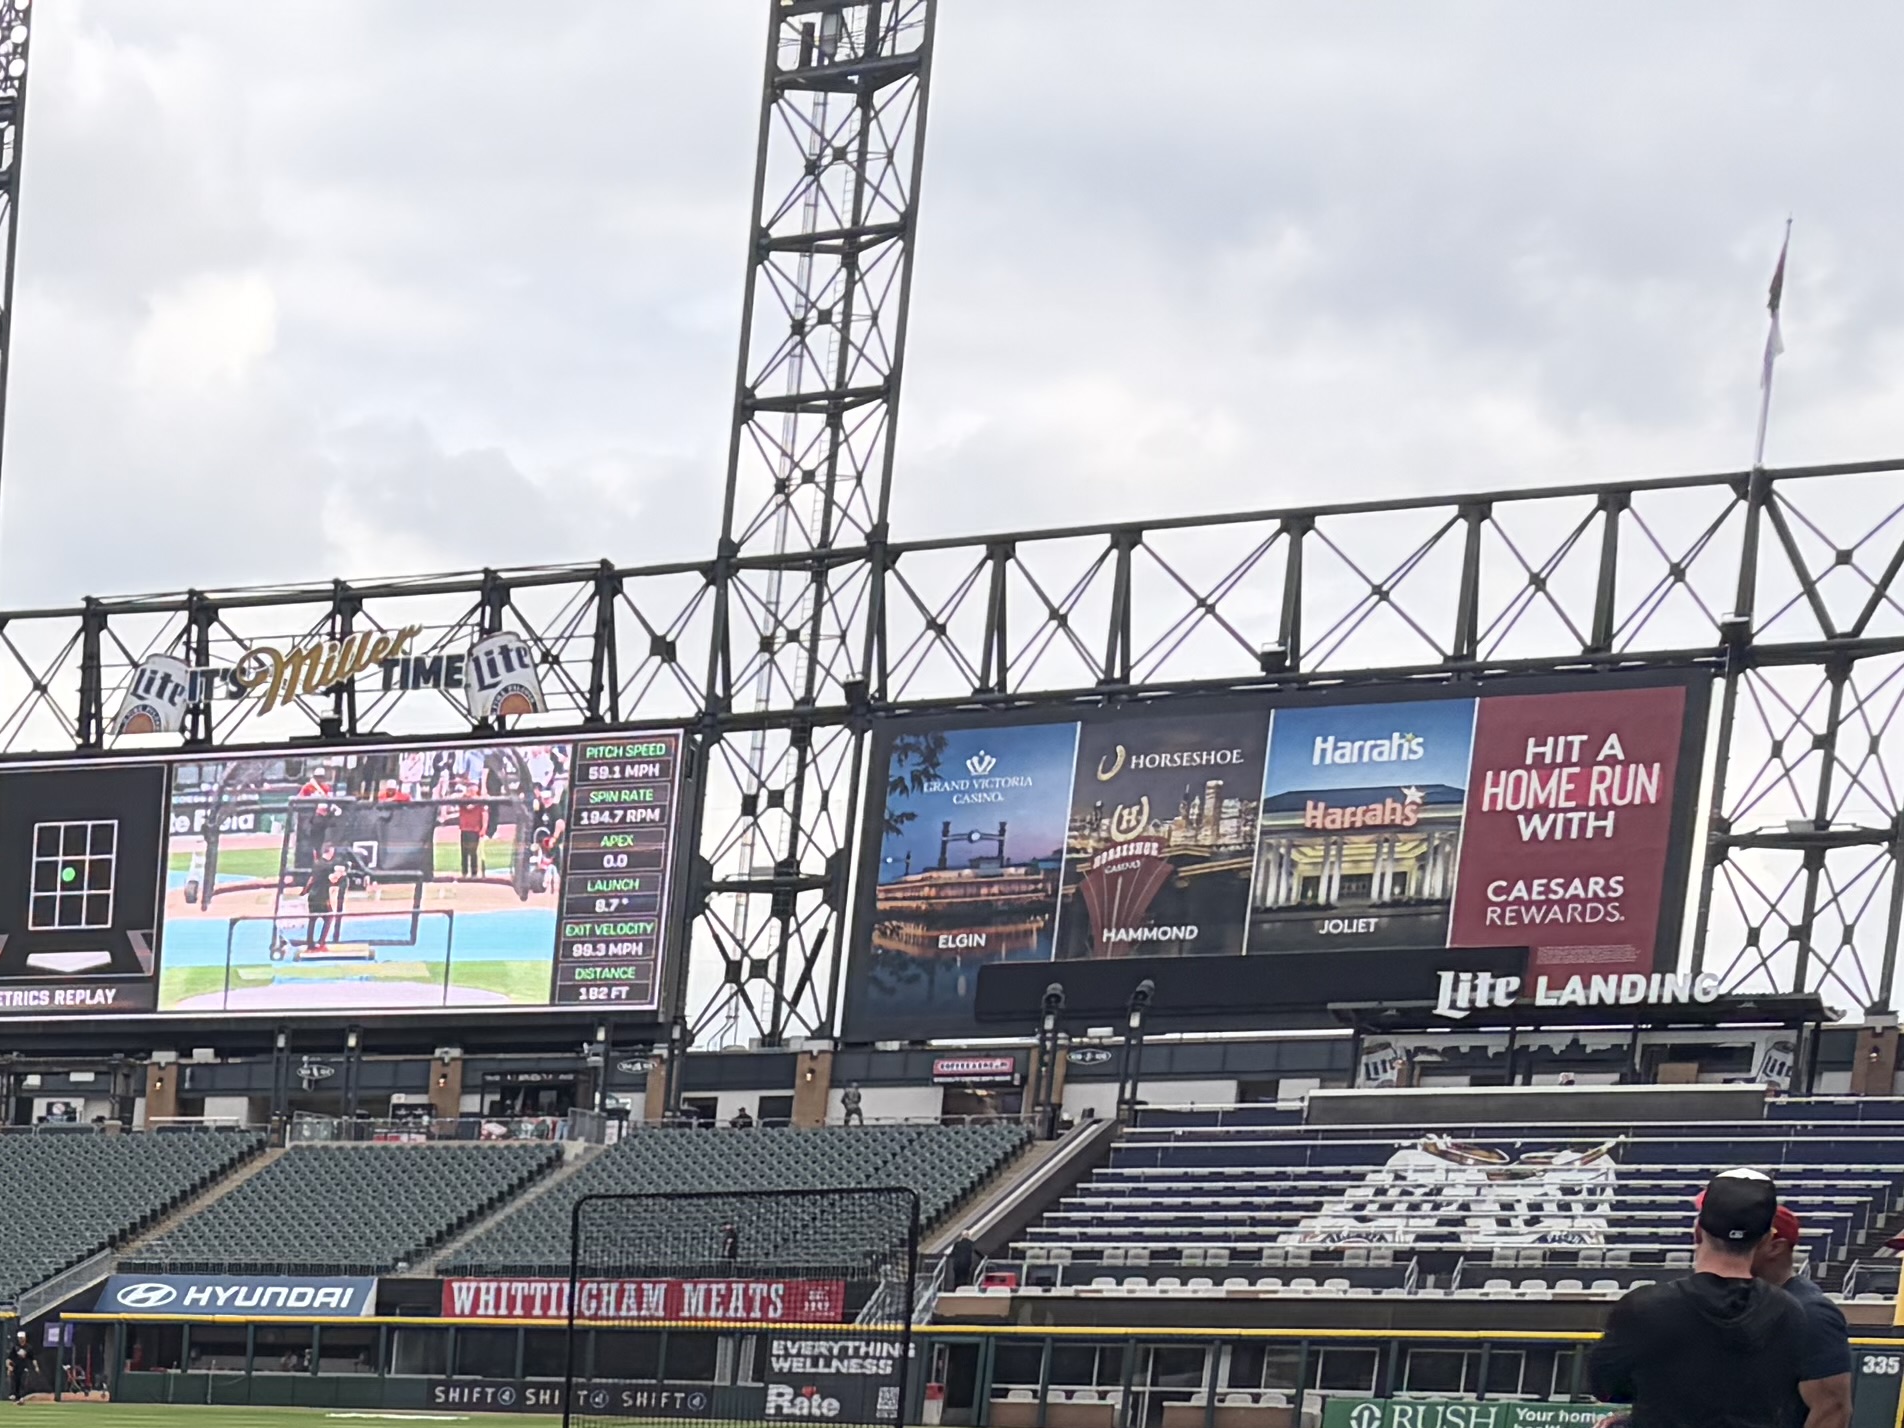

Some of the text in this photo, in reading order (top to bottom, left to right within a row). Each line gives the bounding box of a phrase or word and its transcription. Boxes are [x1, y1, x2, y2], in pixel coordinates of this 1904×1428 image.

[236, 624, 424, 717] Miller
[378, 653, 468, 692] TIME
[472, 644, 530, 692] Lite
[131, 668, 186, 707] Lite
[586, 743, 666, 759] PITCH SPEED
[1525, 733, 1624, 764] HIT A
[624, 763, 660, 778] MPH
[923, 775, 1033, 793] GRAND VICTORIA
[1482, 762, 1660, 812] HOME RUN
[590, 789, 654, 804] SPIN RATE
[626, 808, 661, 822] RPM
[1517, 811, 1615, 841] WITH
[600, 834, 634, 847] APEX
[587, 878, 640, 892] LAUNCH
[1486, 876, 1624, 902] CAESARS
[566, 922, 654, 937] EXIT VELOCITY
[1102, 926, 1199, 943] HAMMOND
[1319, 917, 1379, 934] JOLIET
[608, 942, 643, 956] MPH
[938, 933, 986, 949] ELGIN
[574, 966, 637, 981] DISTANCE
[54, 988, 116, 1006] REPLAY
[610, 986, 630, 999] FT
[1433, 970, 1721, 1019] Lite LANDING
[183, 1285, 354, 1308] HYUNDAI
[451, 1280, 785, 1319] WHITTINGHAM MEATS
[771, 1357, 893, 1375] WELLNESS
[1862, 1355, 1900, 1374] 335
[765, 1384, 841, 1418] Rate
[1516, 1407, 1553, 1422] Your
